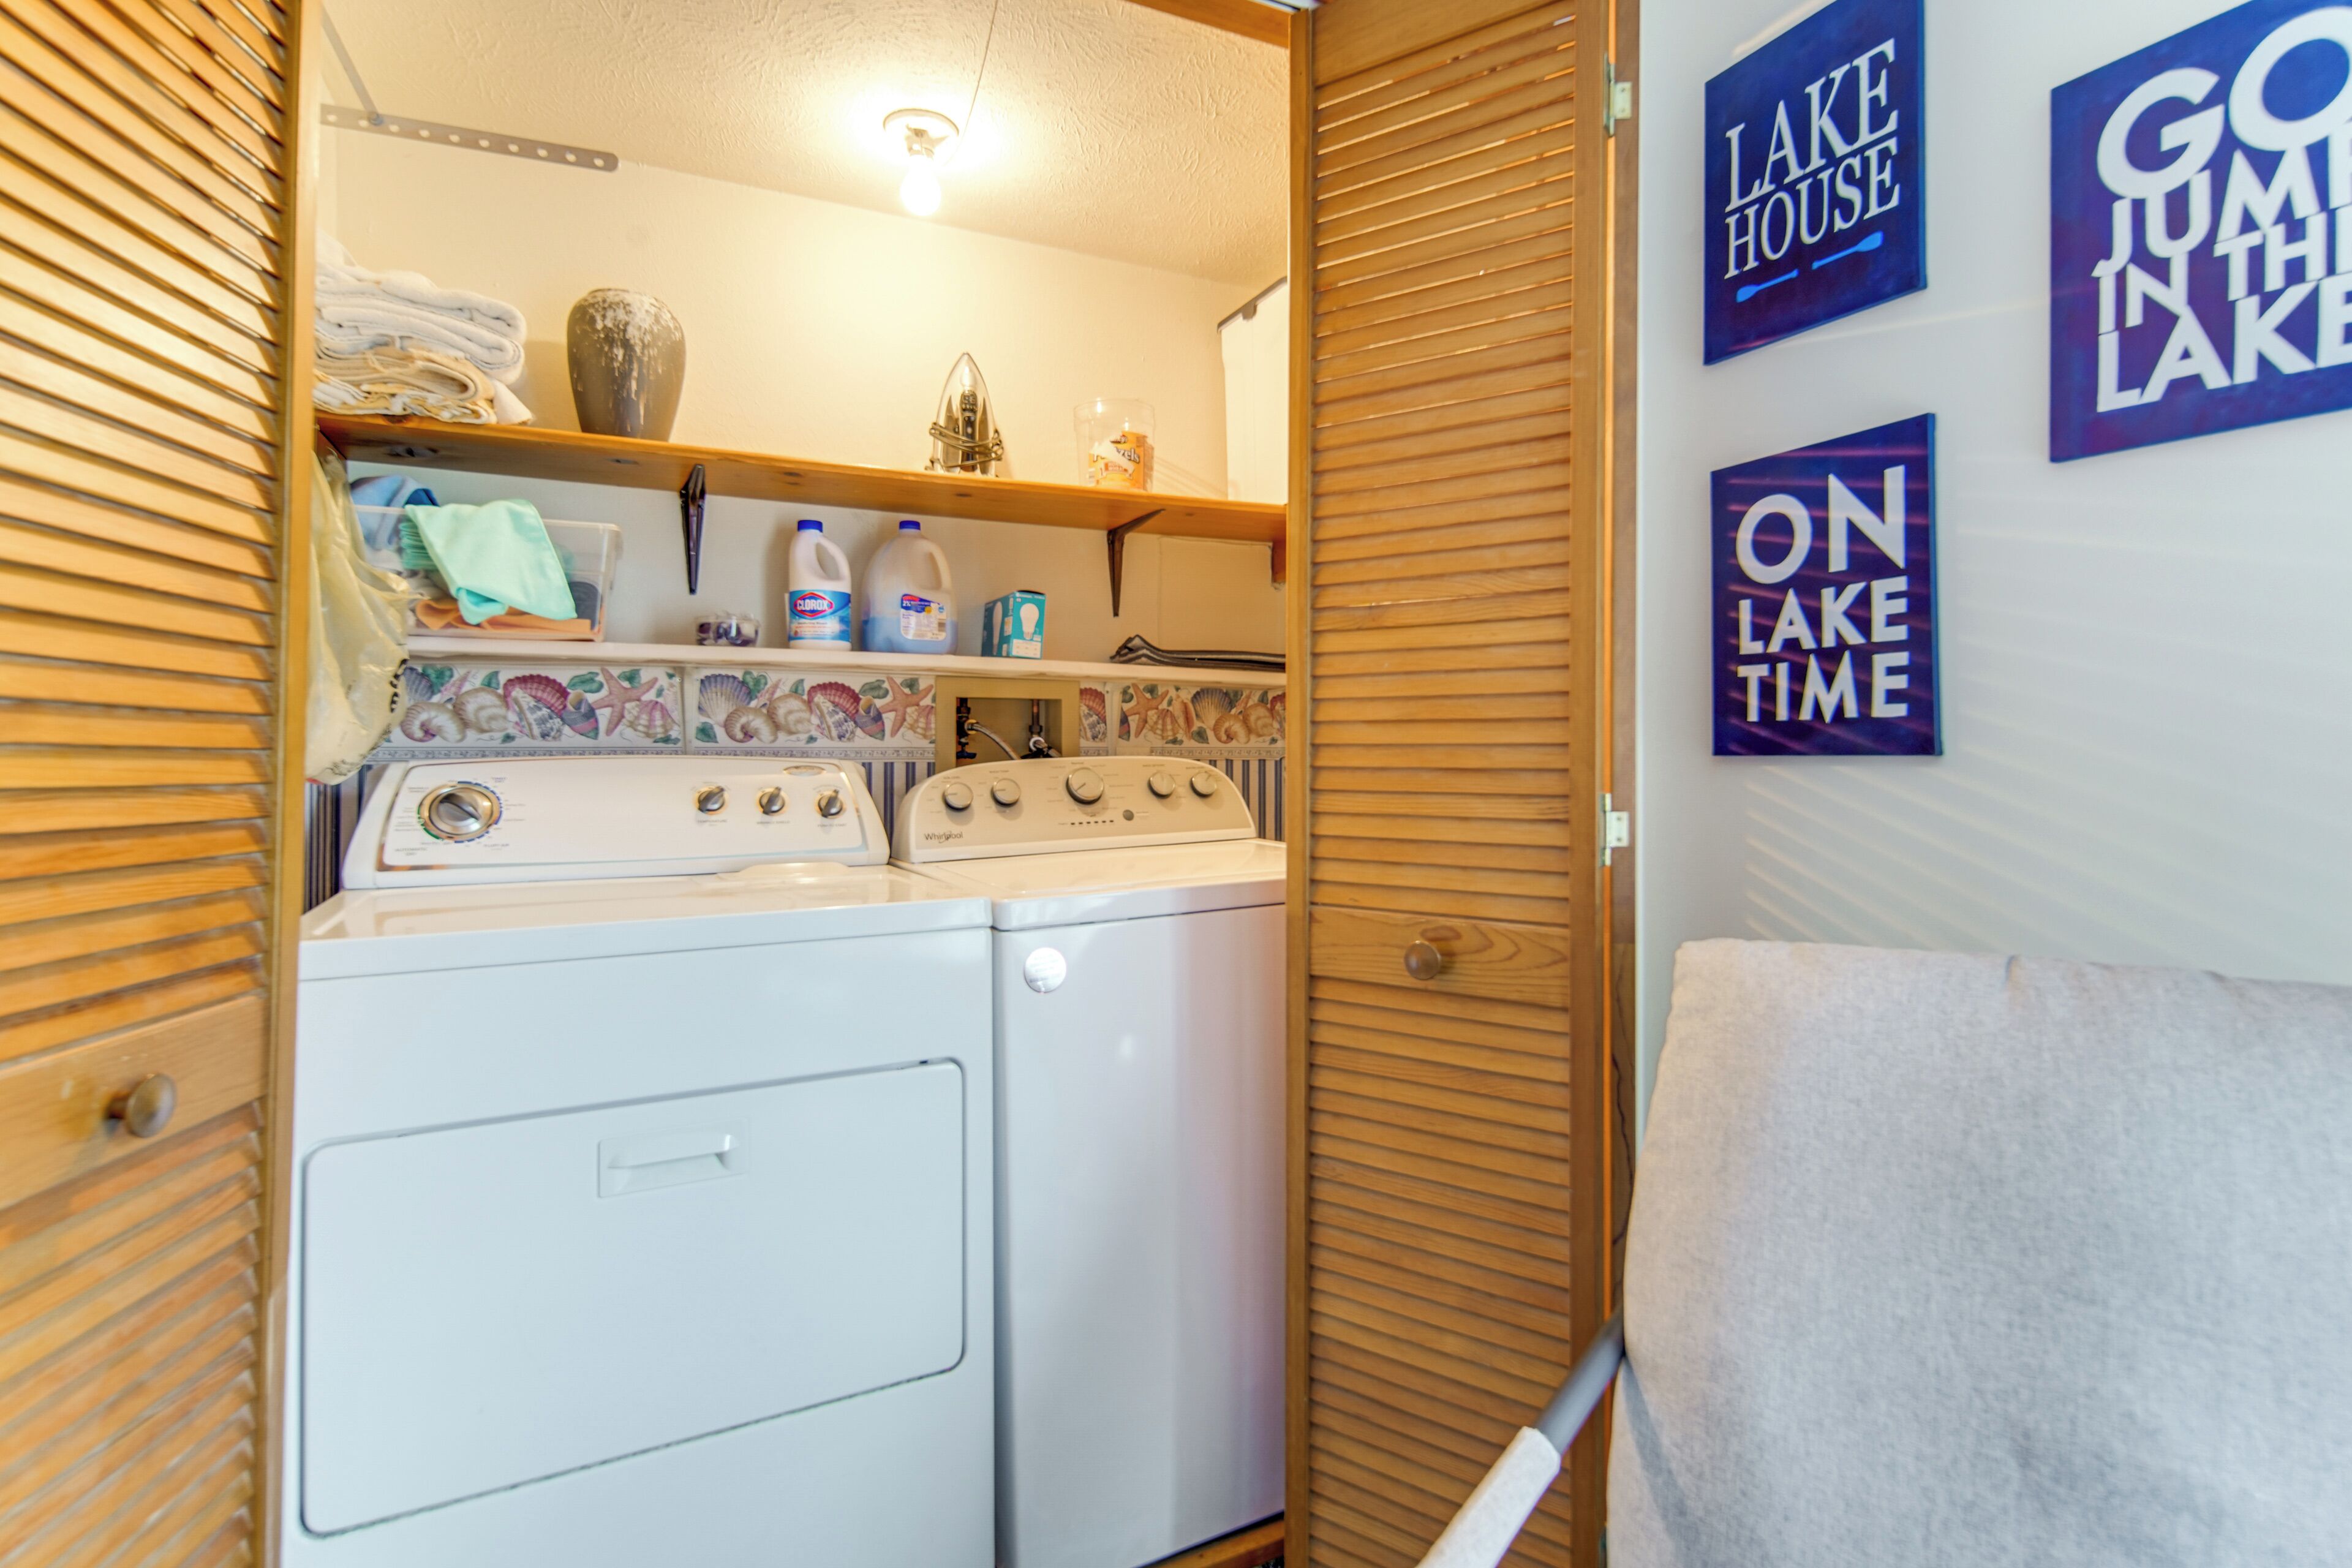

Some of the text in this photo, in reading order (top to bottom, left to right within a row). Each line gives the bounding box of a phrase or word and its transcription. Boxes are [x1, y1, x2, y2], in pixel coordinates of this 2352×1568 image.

[1725, 37, 1899, 212] LAKE
[2097, 6, 2352, 199] GO
[1724, 137, 1900, 280] HOUSE
[2097, 272, 2352, 413] LAKE
[2098, 252, 2188, 335] IN
[1736, 465, 1905, 584] ON
[797, 599, 829, 611] CLOROX
[1739, 576, 1907, 655] LAKE
[1737, 650, 1909, 723] TIME
[924, 831, 963, 844] Whirlpool
